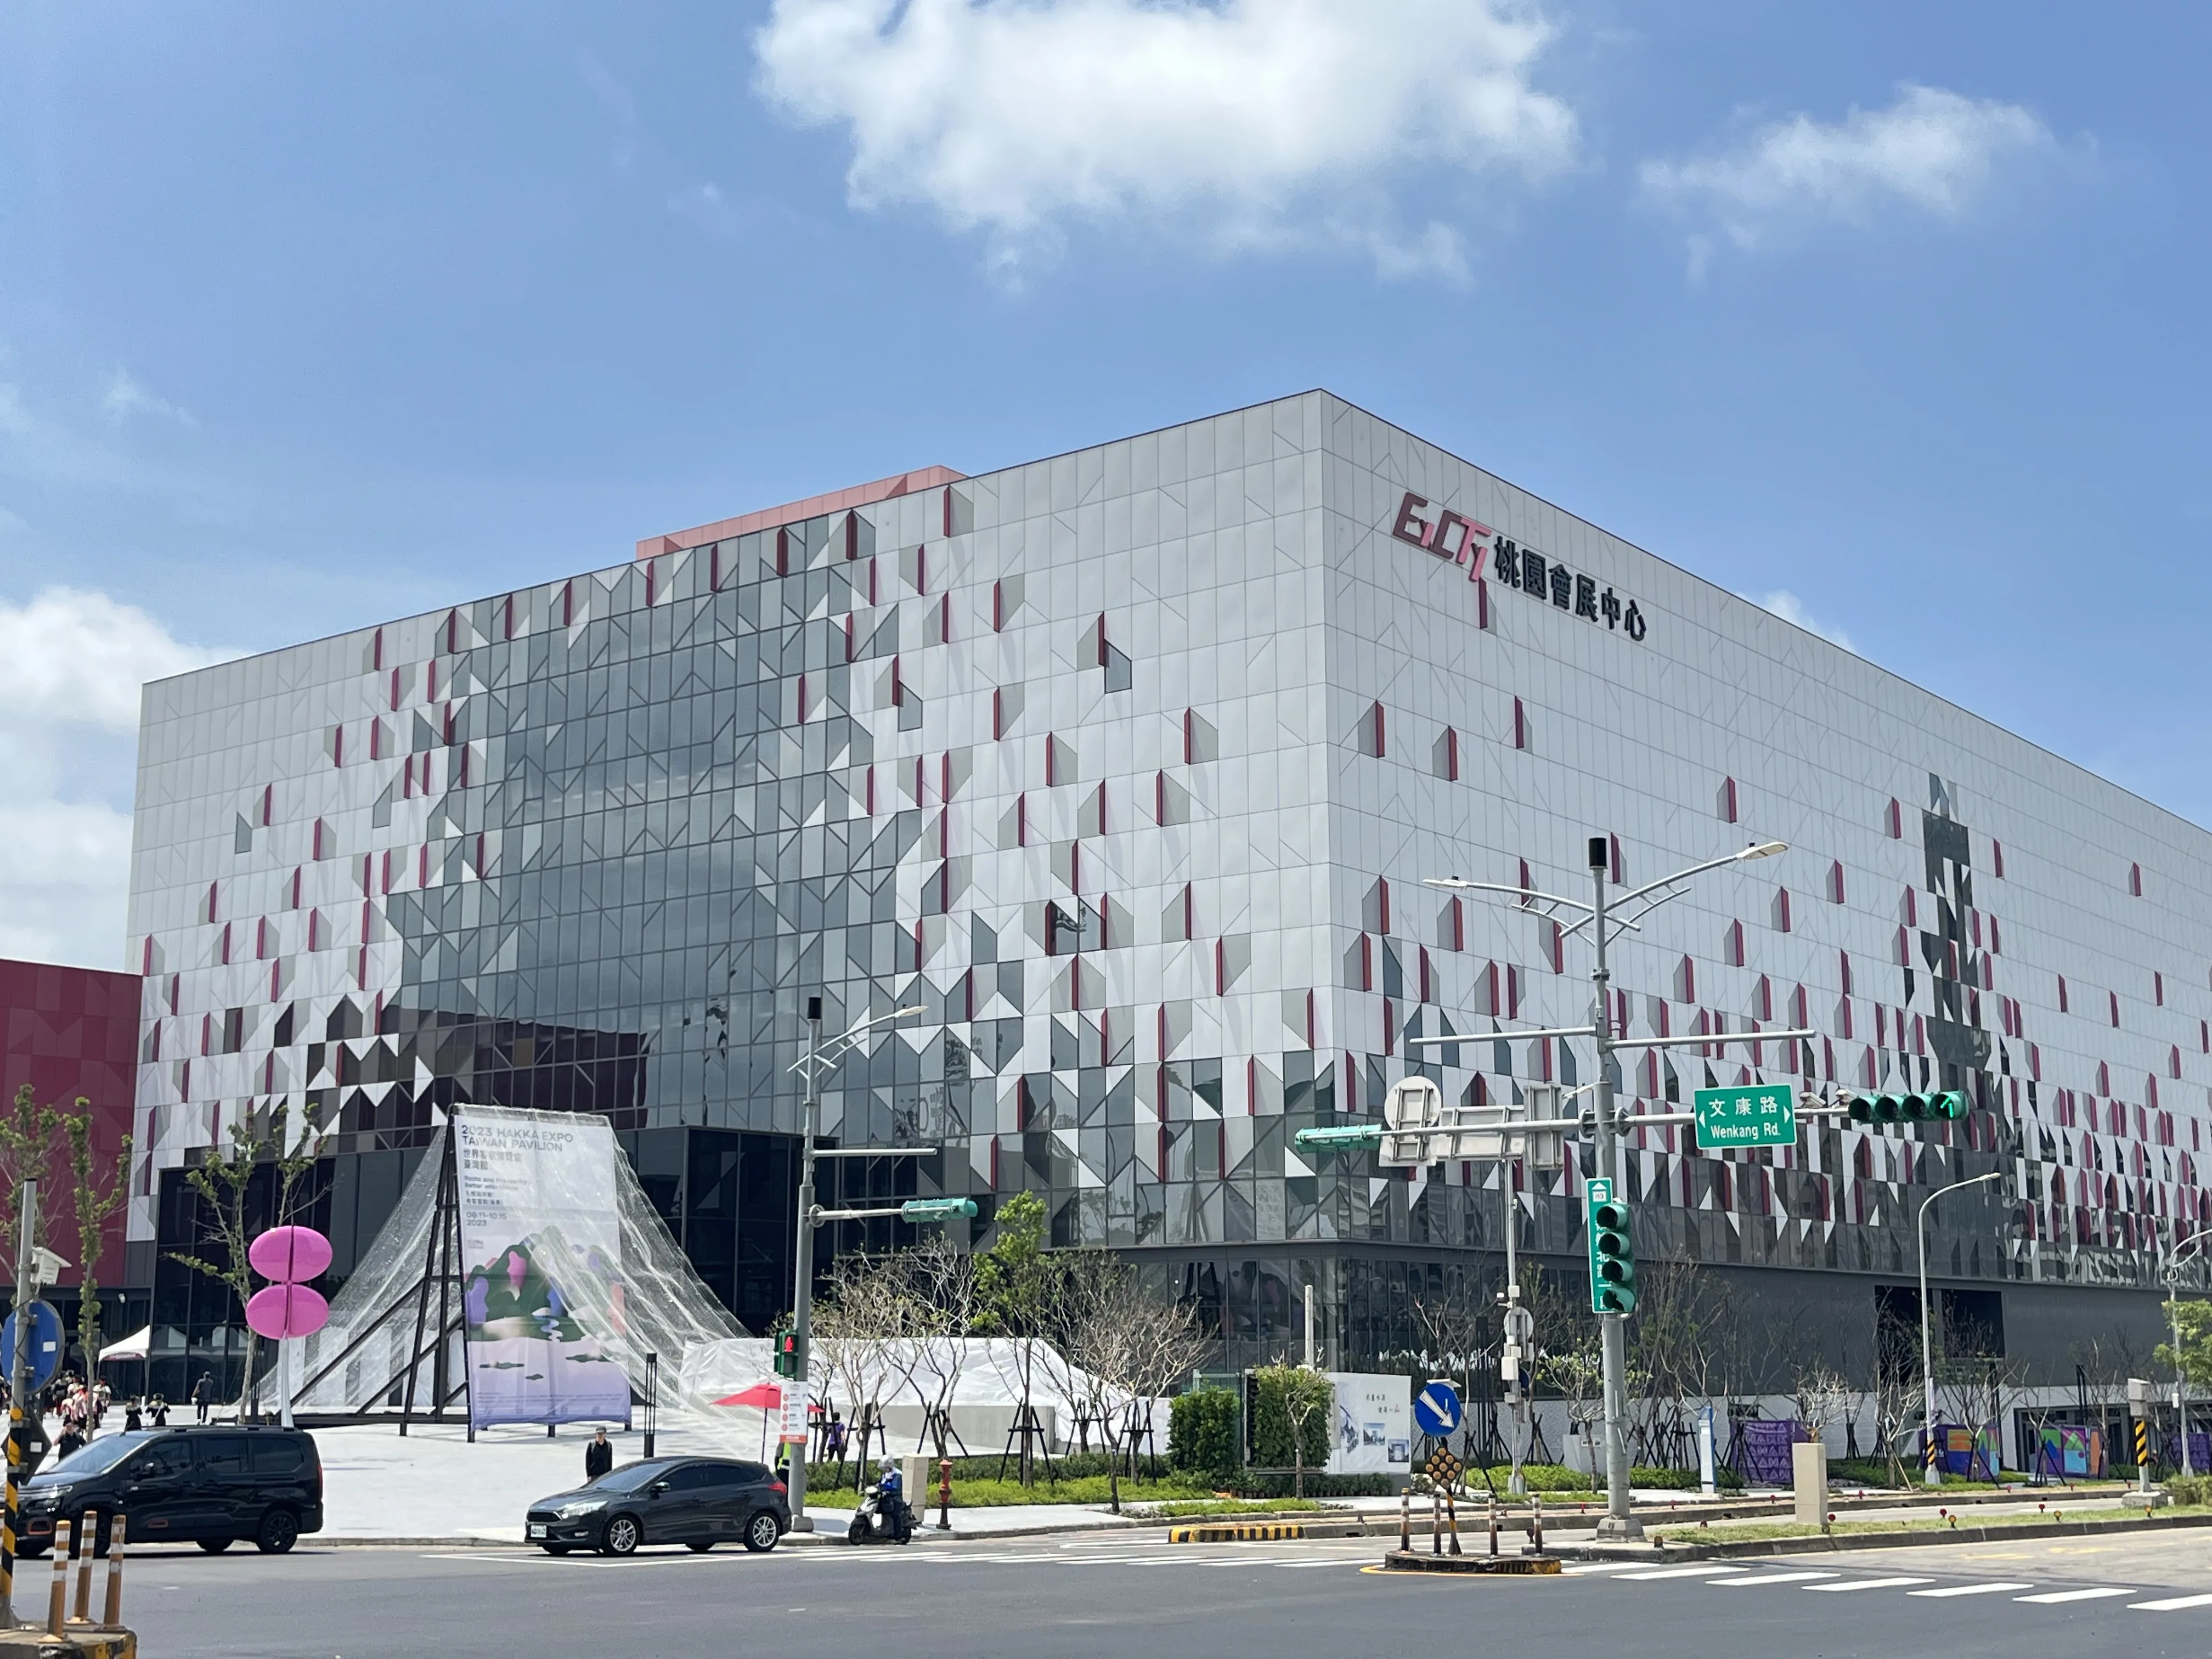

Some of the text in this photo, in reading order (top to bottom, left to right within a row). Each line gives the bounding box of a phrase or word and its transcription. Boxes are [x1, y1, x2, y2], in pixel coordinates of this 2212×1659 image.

[1494, 535, 1646, 641] 桃園會展中心
[1708, 1096, 1778, 1118] 文康路
[461, 1125, 573, 1143] 2023 HAKKA EXPO
[1711, 1122, 1781, 1140] Wenkang Rd.
[462, 1135, 562, 1152] TAIWAN PAVILION
